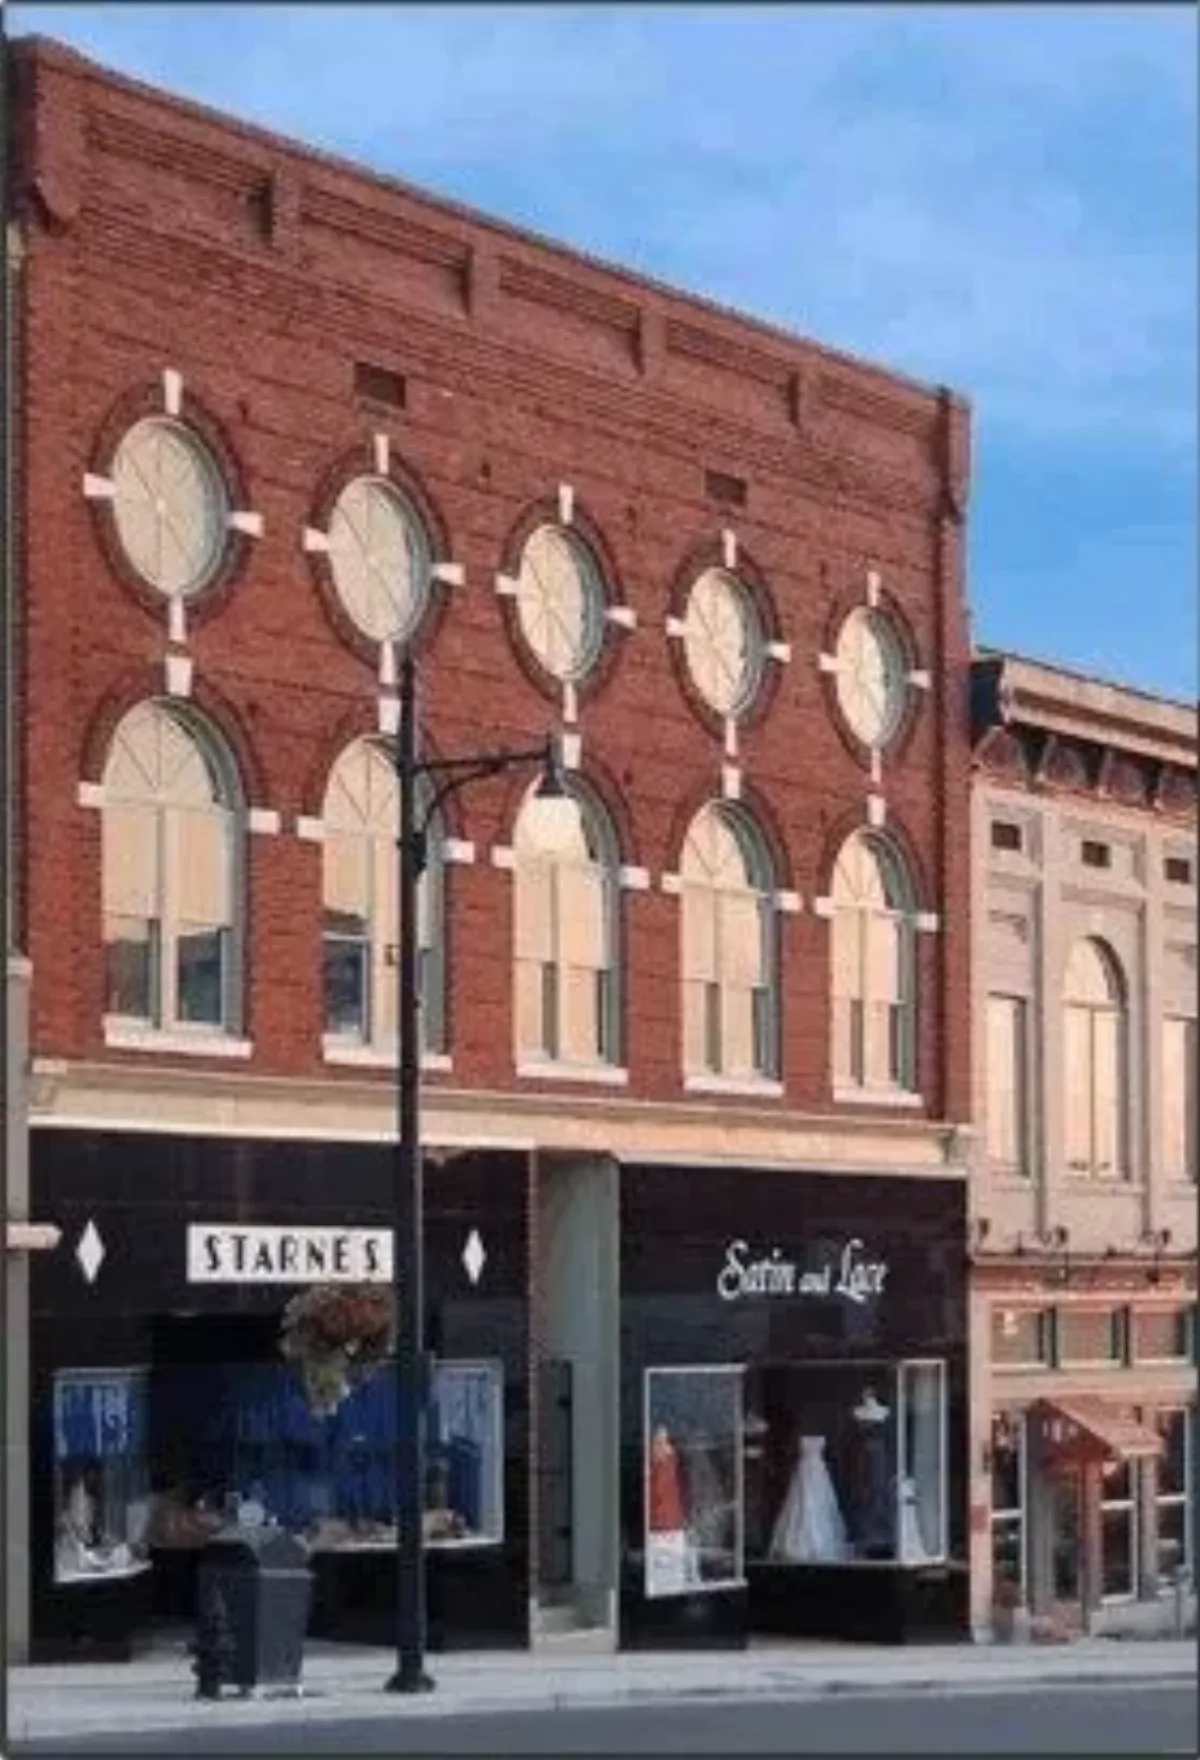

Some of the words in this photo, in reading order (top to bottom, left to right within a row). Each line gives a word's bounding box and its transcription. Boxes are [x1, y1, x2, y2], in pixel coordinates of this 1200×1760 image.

[204, 1233, 379, 1273] STARNES
[717, 1239, 796, 1300] Satin
[799, 1265, 831, 1294] and
[833, 1238, 889, 1303] Lace
